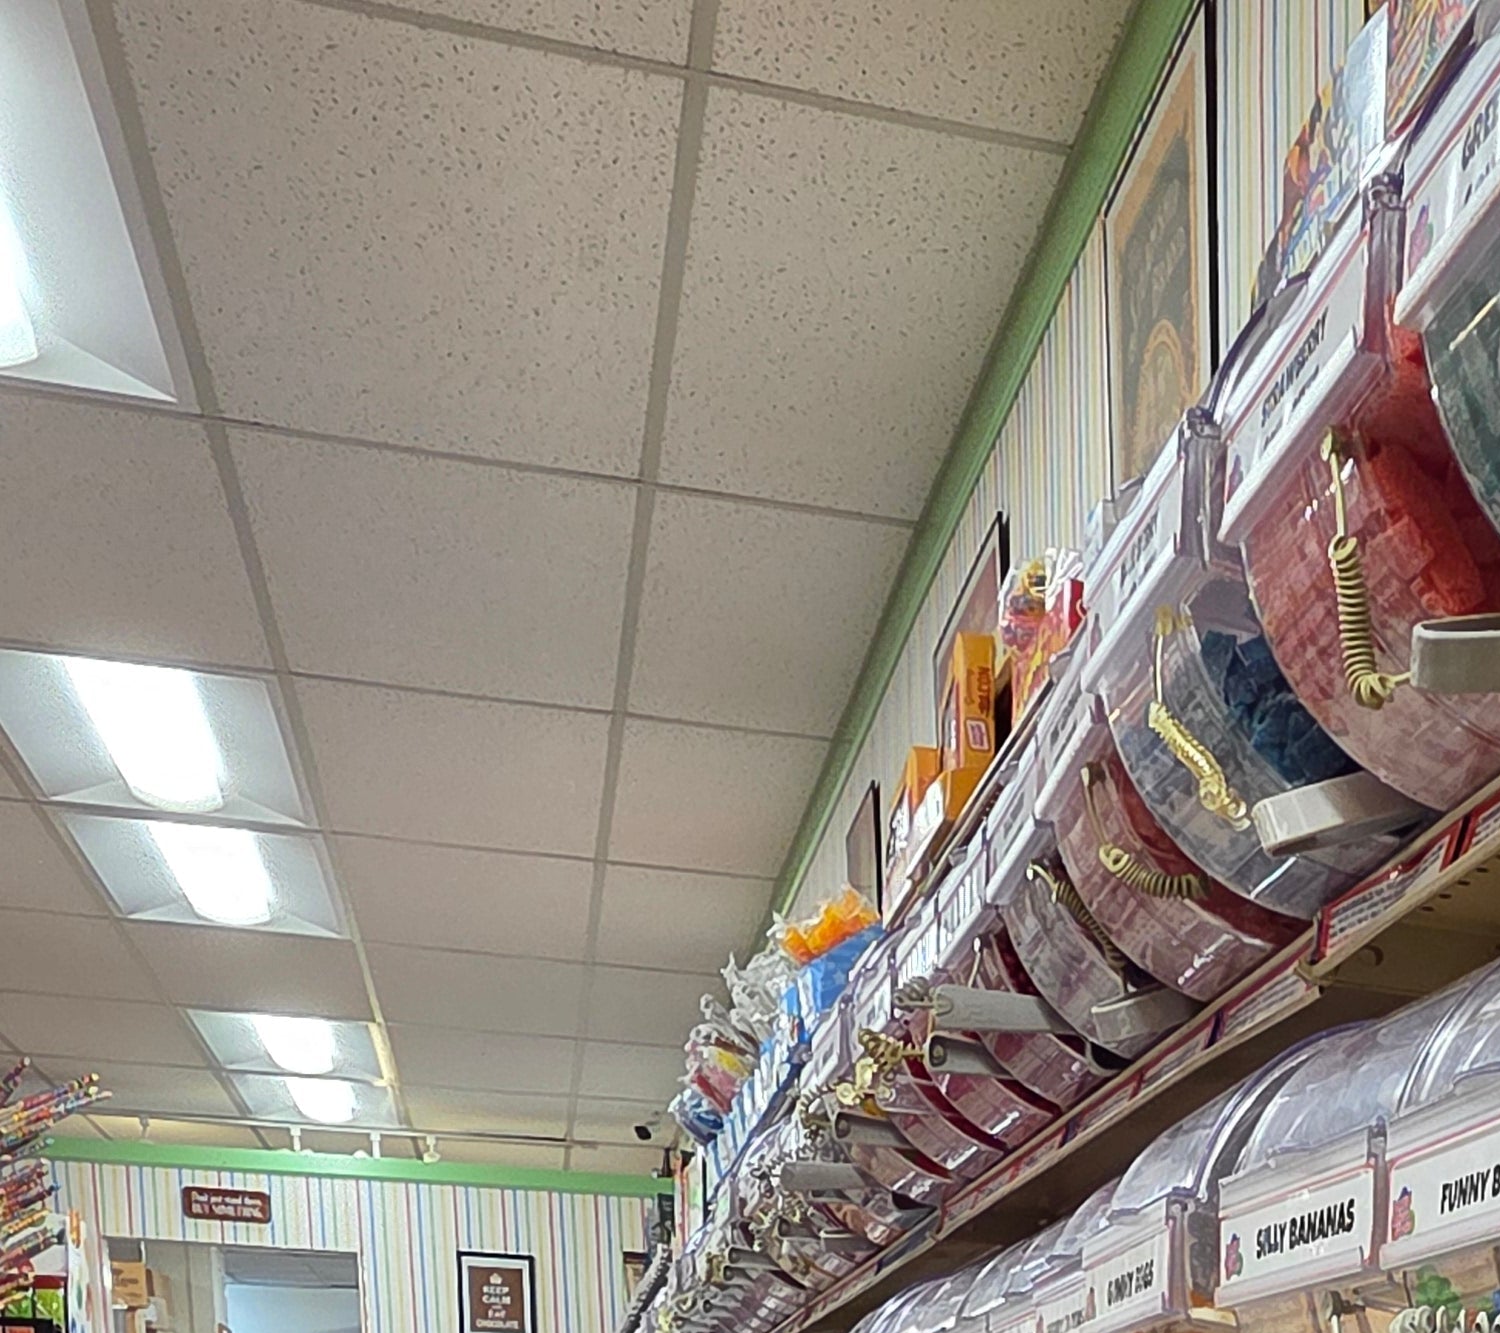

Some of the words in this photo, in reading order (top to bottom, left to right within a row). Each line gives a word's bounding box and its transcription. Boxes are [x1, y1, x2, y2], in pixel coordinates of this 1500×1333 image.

[1441, 1170, 1490, 1213] FUNNY
[1257, 1223, 1286, 1259] SILLY
[1290, 1199, 1354, 1249] BANANAS
